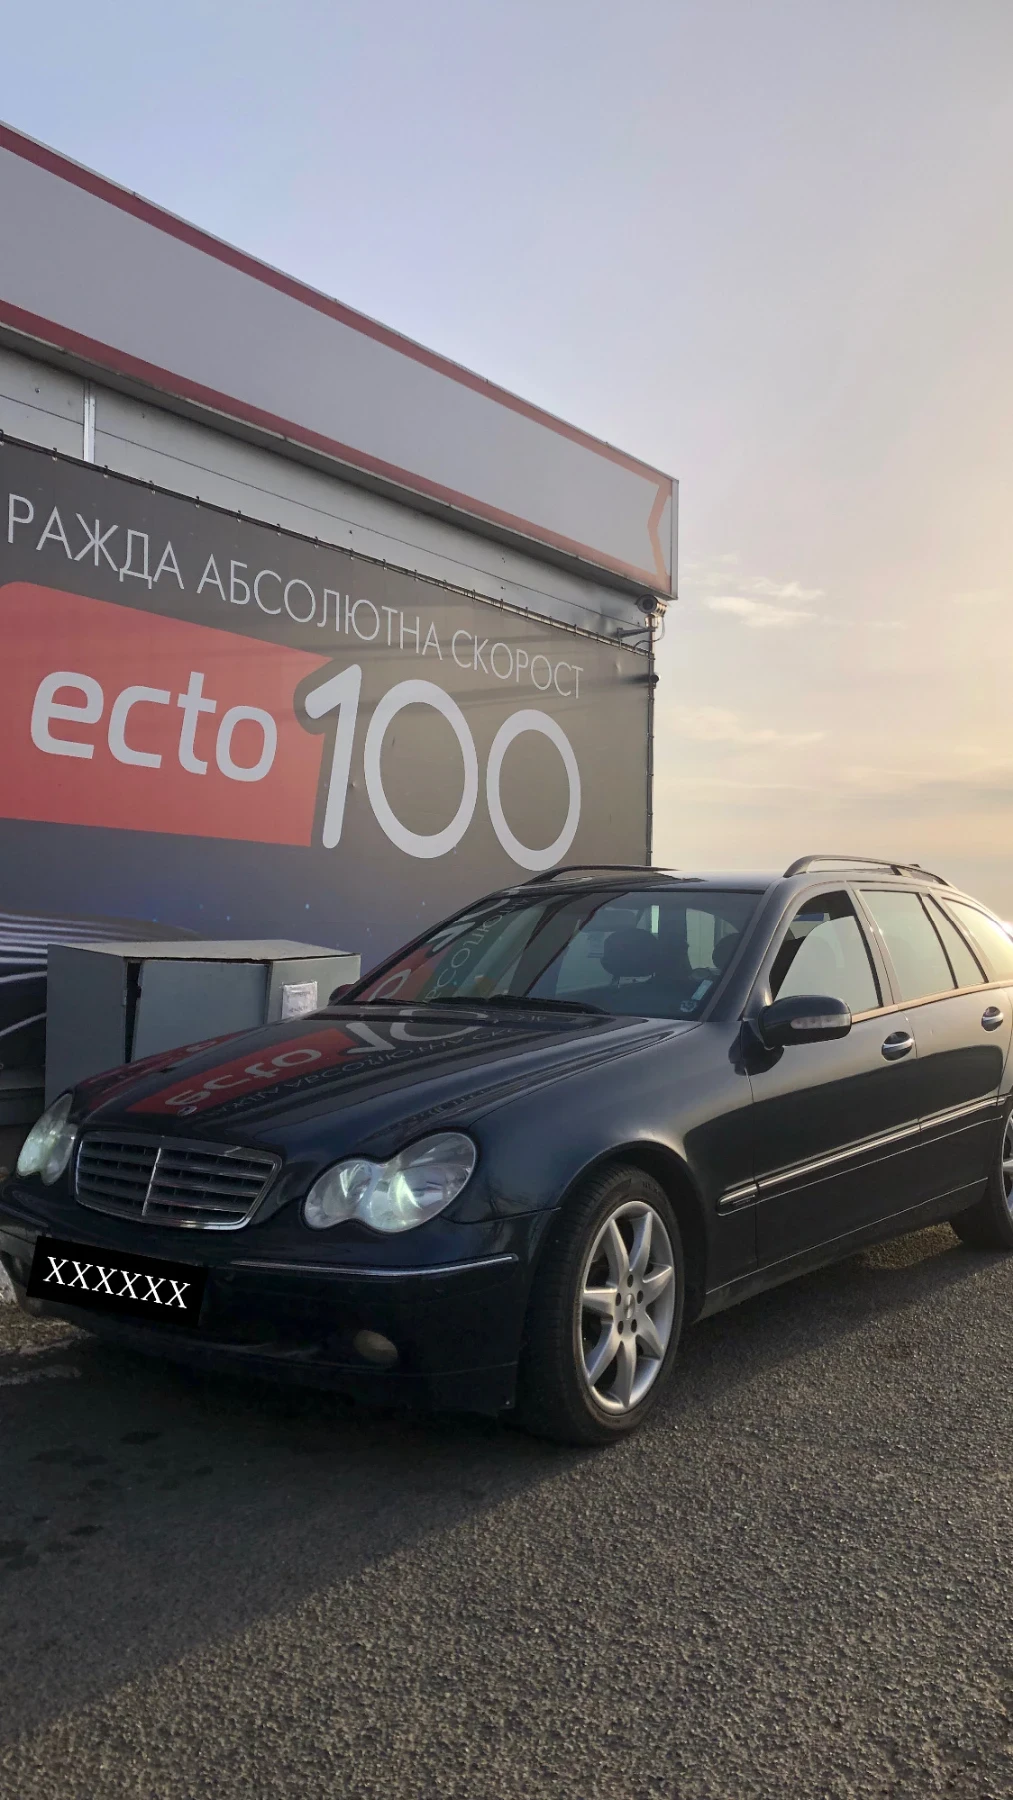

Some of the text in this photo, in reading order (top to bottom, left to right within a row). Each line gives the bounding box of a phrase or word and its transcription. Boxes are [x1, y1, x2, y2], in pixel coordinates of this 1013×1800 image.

[8, 493, 584, 699] РАЖДА АБСОЛЮТНА СКОРОСТ
[30, 663, 582, 871] ecto 100
